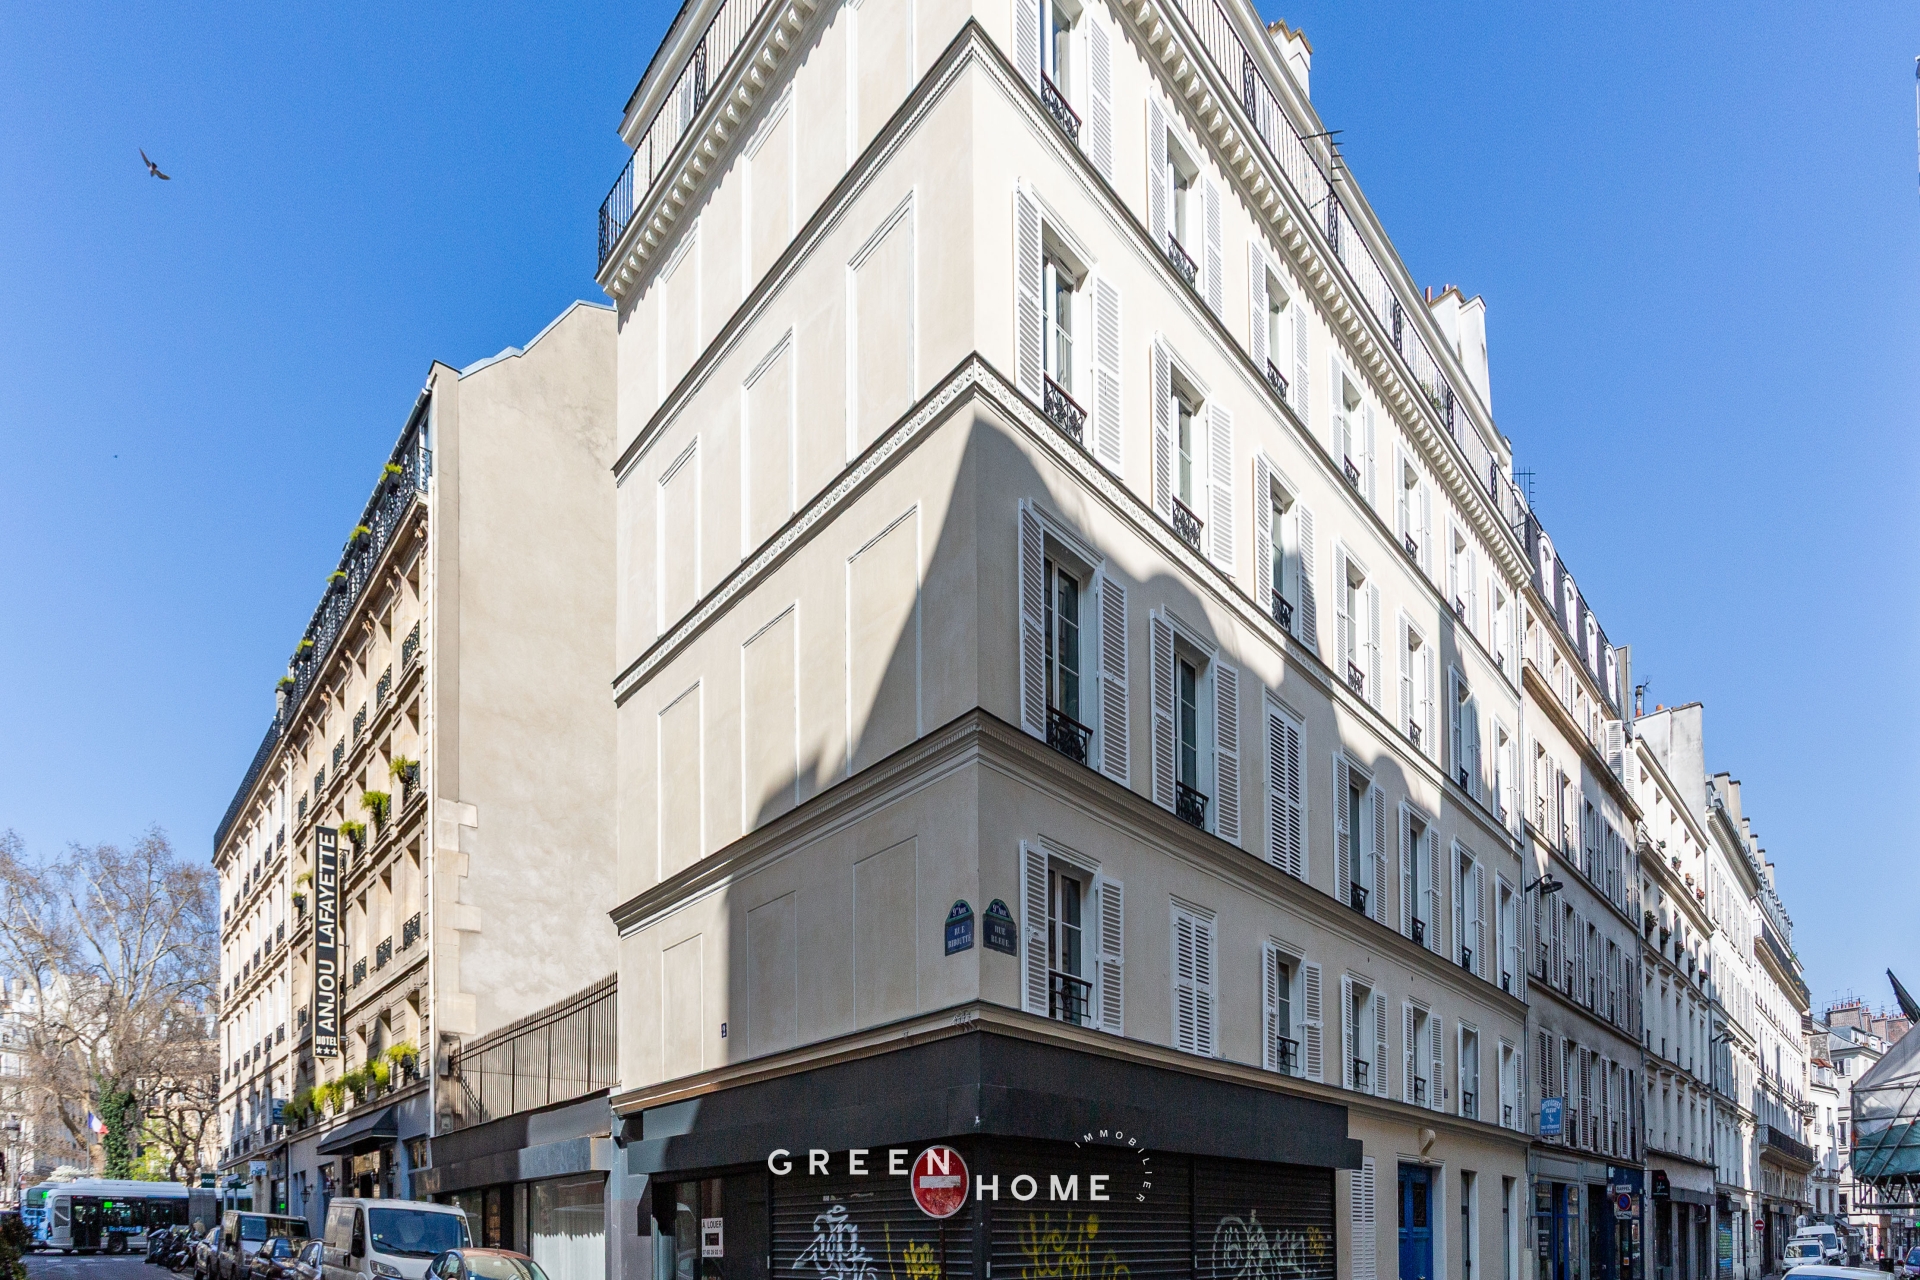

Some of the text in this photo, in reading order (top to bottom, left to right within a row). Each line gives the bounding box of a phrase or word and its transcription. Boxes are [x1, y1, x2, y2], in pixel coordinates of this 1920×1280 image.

[318, 832, 335, 1032] ANJOU LAFAYETTE
[954, 925, 966, 936] RUE
[994, 925, 1006, 936] RUE
[990, 934, 1010, 947] BLEUE
[316, 1035, 337, 1046] HOTEL
[707, 1220, 723, 1229] LOUER
